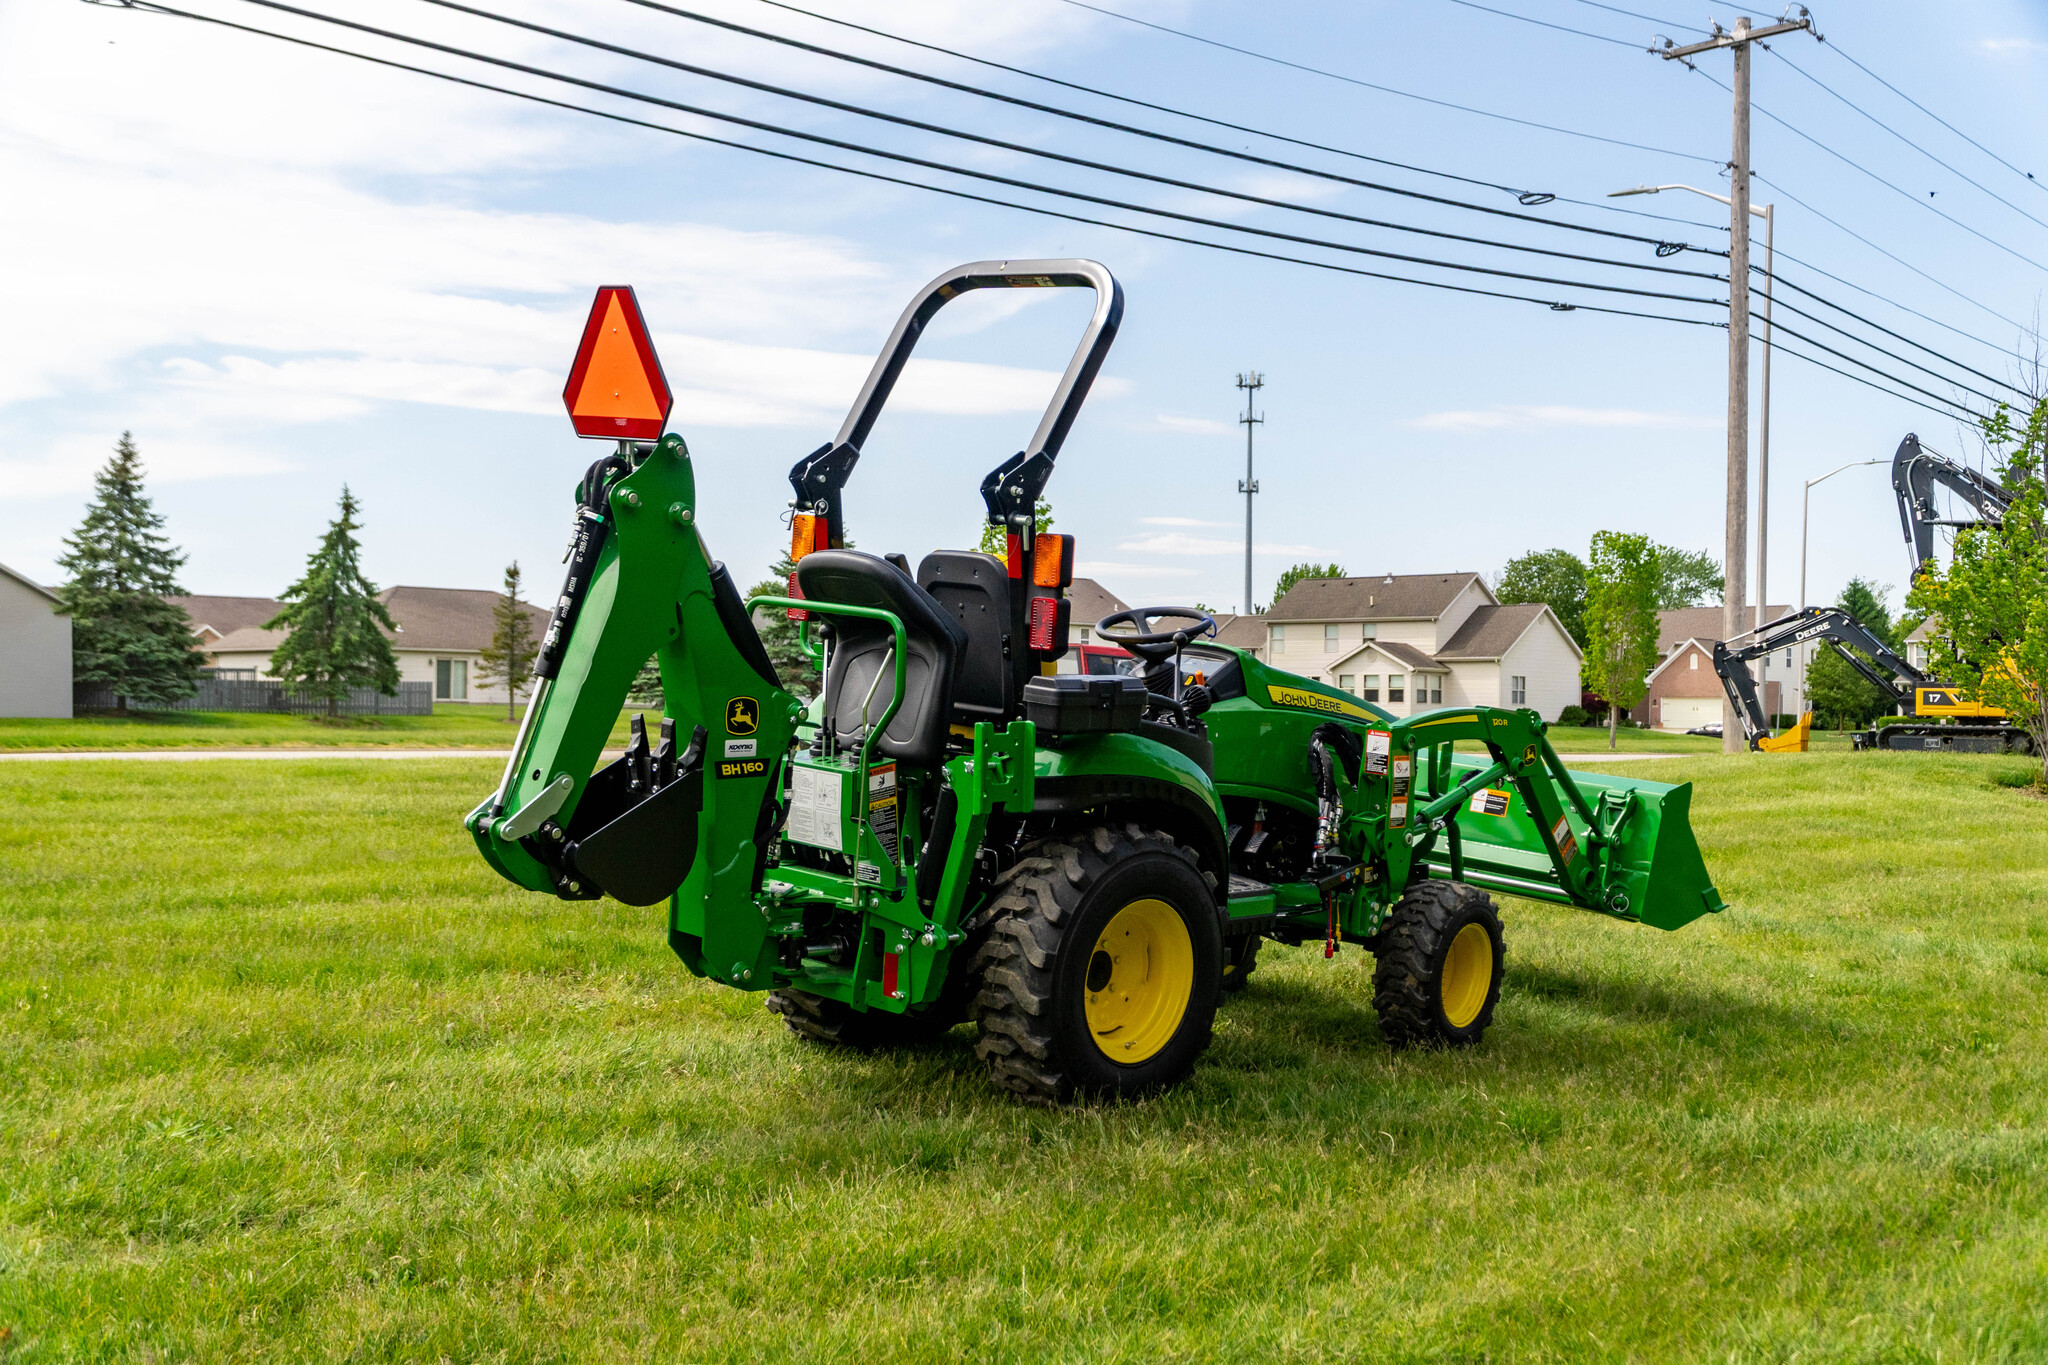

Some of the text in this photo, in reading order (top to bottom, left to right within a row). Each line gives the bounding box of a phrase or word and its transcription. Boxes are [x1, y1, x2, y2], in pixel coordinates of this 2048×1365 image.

[1982, 500, 2003, 519] DEE
[1795, 621, 1831, 641] DEERE
[1278, 691, 1342, 712] JOHN DEERE
[1928, 693, 1941, 703] 17
